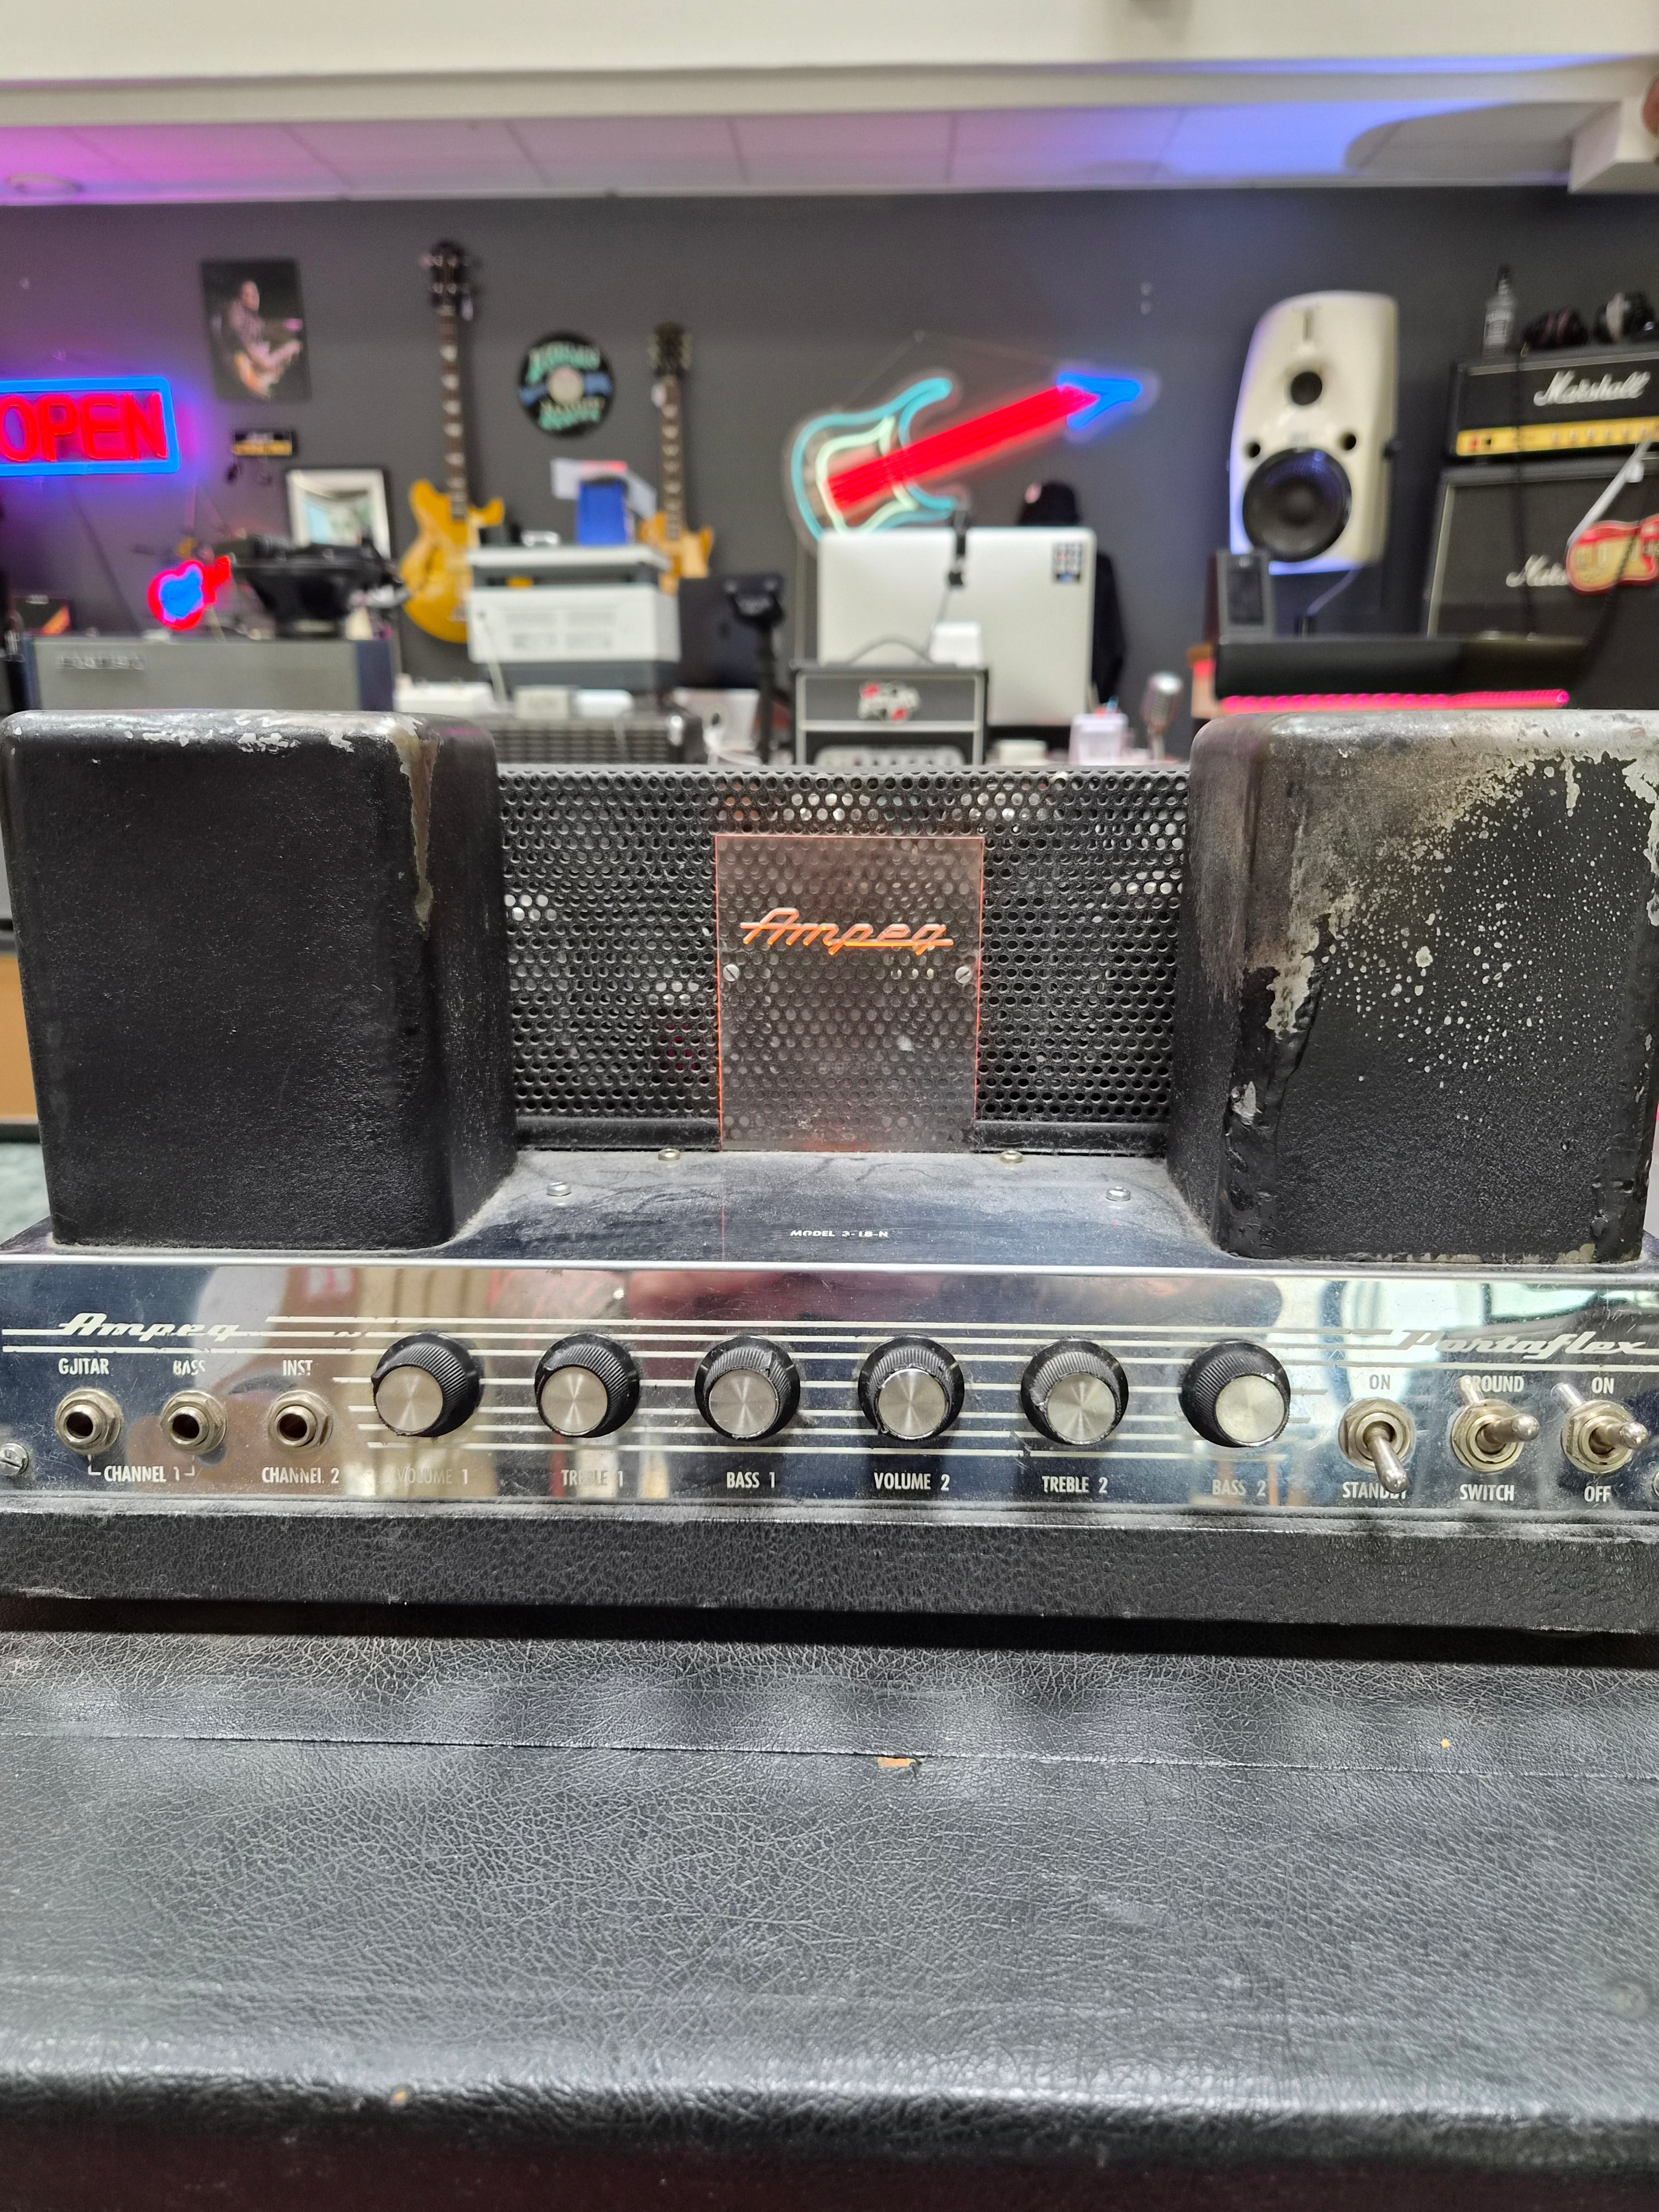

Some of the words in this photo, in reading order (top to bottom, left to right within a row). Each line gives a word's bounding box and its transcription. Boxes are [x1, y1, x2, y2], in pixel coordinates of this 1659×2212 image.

[1533, 370, 1651, 406] Marshall
[0, 392, 168, 462] OPEN
[740, 907, 954, 956] Ampeg
[58, 1312, 240, 1342] Ampeg
[1399, 1329, 1646, 1360] Portaflex
[173, 1360, 206, 1376] BASS
[283, 1360, 313, 1376] INST
[1369, 1374, 1391, 1390] ON
[1592, 1377, 1614, 1395] ON
[103, 1465, 166, 1483] CHANNEL
[173, 1467, 180, 1481] 1
[262, 1467, 325, 1484] CHANNEL
[331, 1467, 340, 1484] 2
[397, 1469, 453, 1484] VOLUME
[462, 1469, 468, 1485] 1
[561, 1469, 608, 1486] TREBLE
[617, 1470, 623, 1487] 1
[726, 1472, 760, 1489] BASS
[769, 1472, 775, 1489] 1
[874, 1472, 931, 1490] VOLUME
[941, 1474, 950, 1491] 2
[1042, 1475, 1089, 1493] TREBLE
[1098, 1477, 1108, 1494] 2
[1212, 1479, 1246, 1496] BASS
[1256, 1480, 1266, 1497] 2
[1459, 1484, 1515, 1501] SWITCH
[1584, 1485, 1611, 1503] OFF
